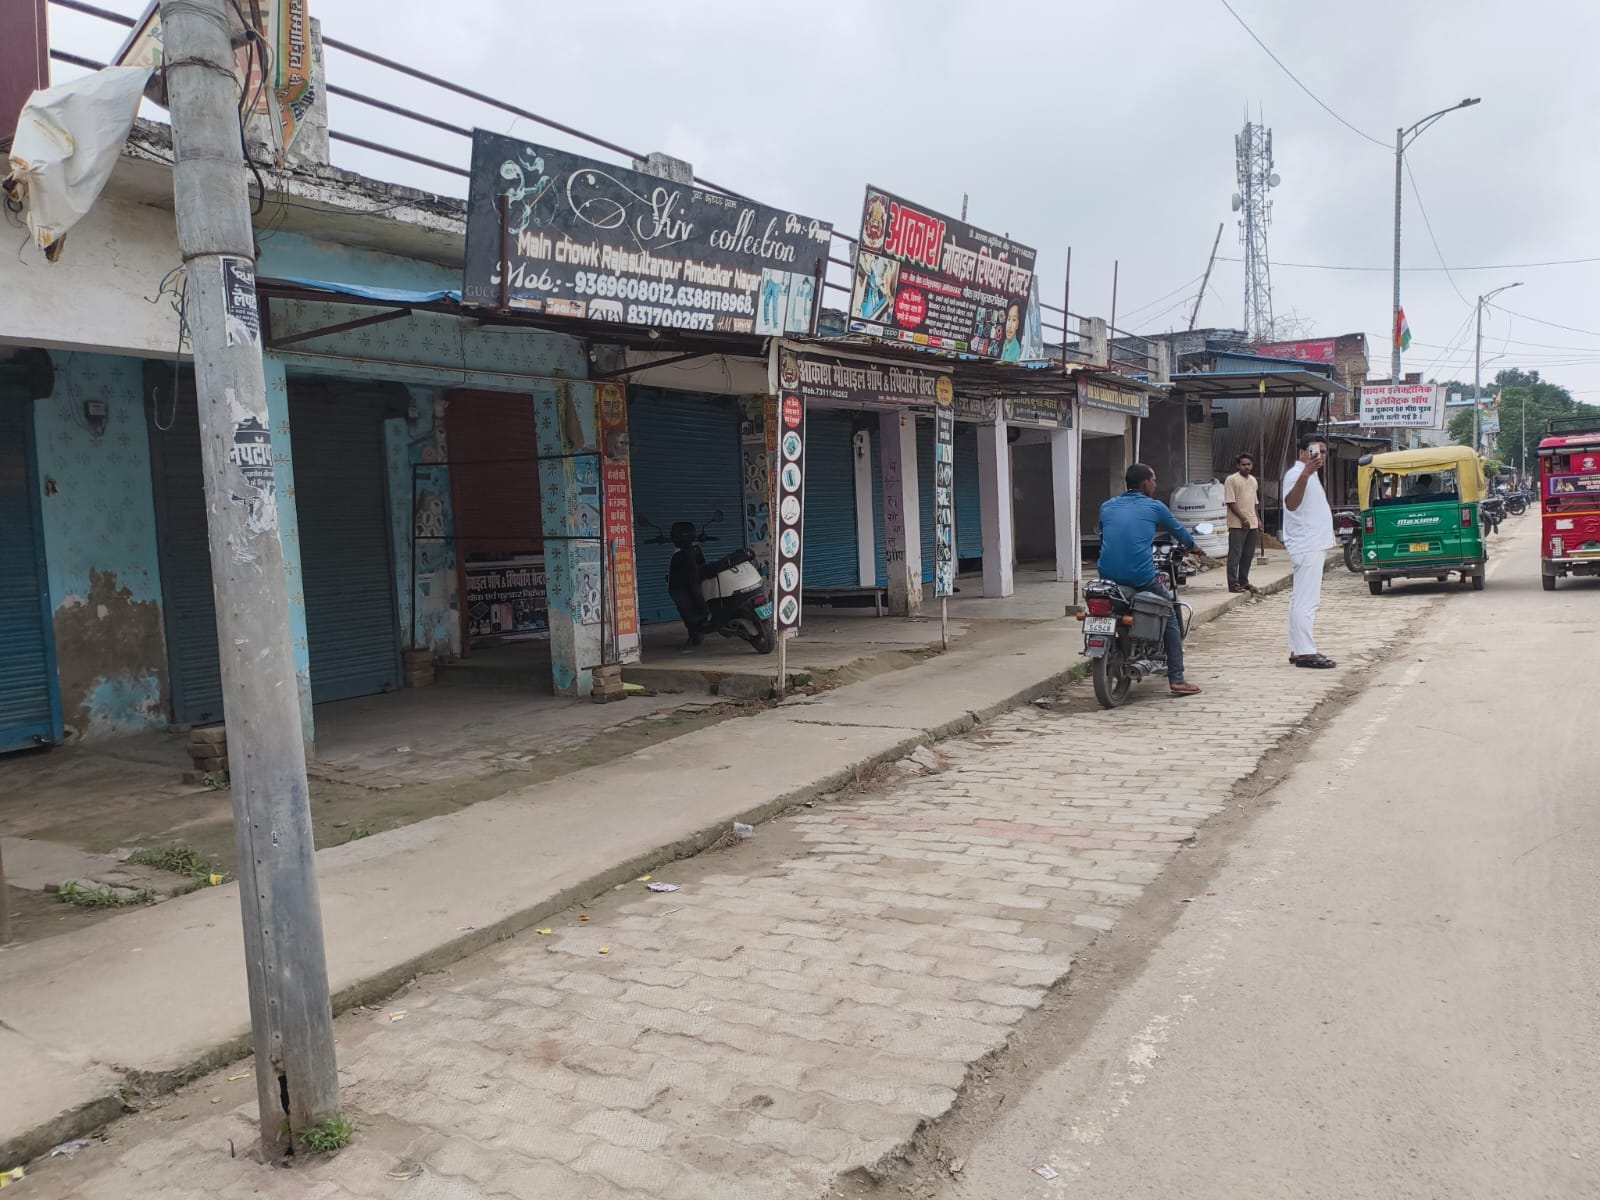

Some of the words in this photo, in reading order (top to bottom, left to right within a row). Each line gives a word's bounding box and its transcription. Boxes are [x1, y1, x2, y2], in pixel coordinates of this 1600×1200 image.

[885, 202, 946, 271] आकाश
[941, 234, 977, 282] मोबाइल
[518, 231, 552, 260] Main
[555, 236, 599, 268] chowk
[600, 244, 682, 284] Rajesultanpur
[683, 259, 734, 288] Ambedkar
[733, 267, 762, 296] Nagar
[626, 304, 715, 331] 8317002673
[799, 359, 832, 385] आकाश
[833, 359, 866, 391] मोबाइल
[867, 364, 883, 392] शॉप
[883, 375, 889, 392] &
